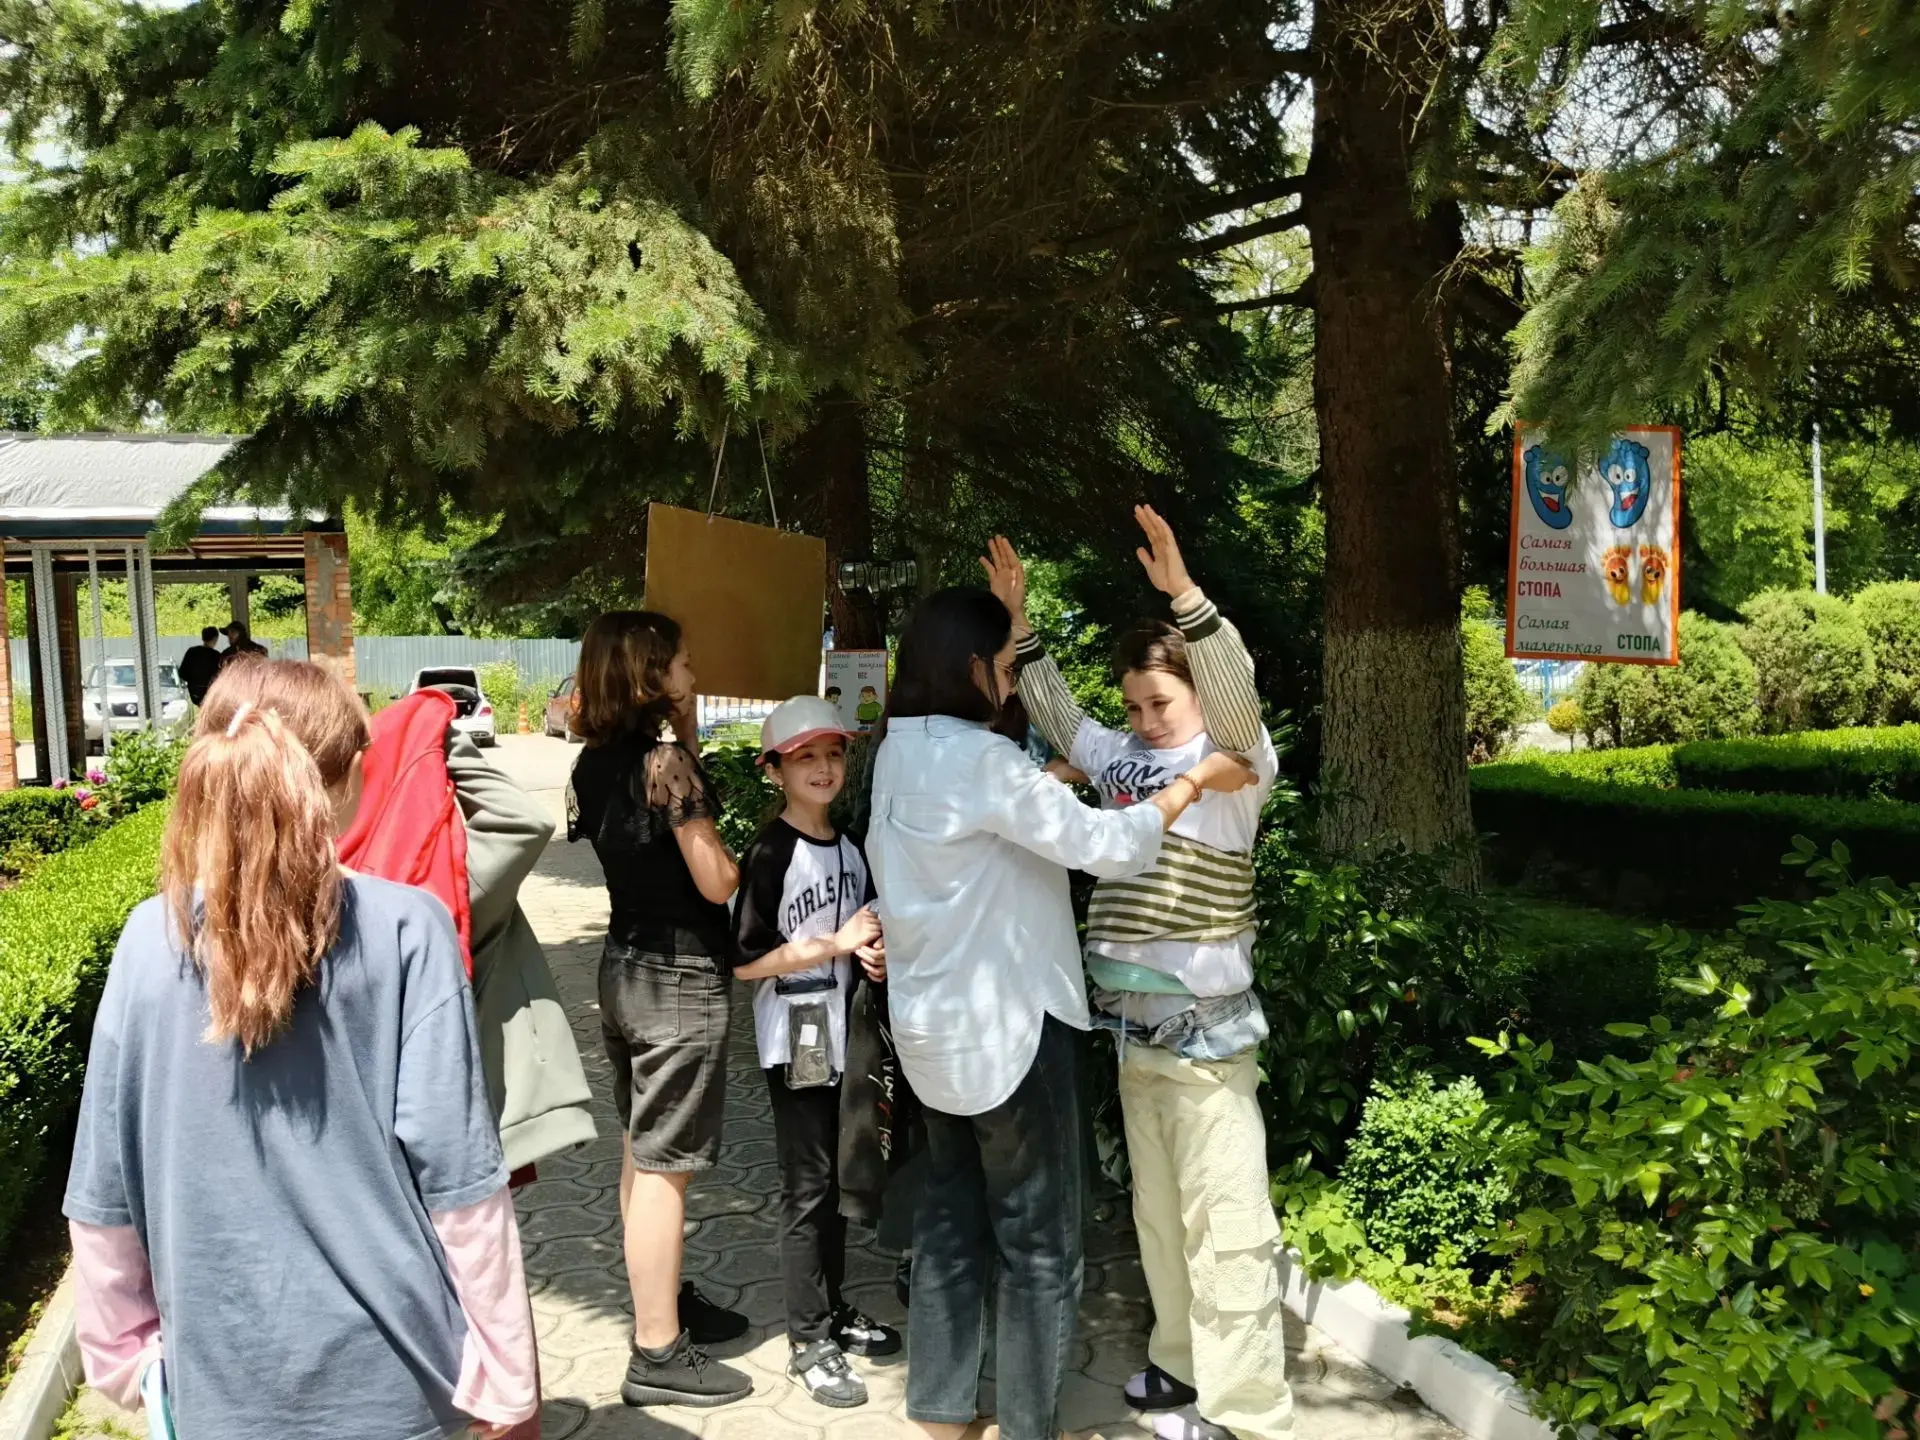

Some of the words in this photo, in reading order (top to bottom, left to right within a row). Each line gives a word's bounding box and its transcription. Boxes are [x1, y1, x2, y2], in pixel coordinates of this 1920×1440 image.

[1520, 535, 1572, 549] Самая
[1519, 555, 1587, 573] большая
[1518, 581, 1561, 598] СТОПА
[1517, 615, 1570, 630] Самая
[1516, 640, 1603, 655] маленькая
[1617, 634, 1661, 652] СТОПА
[788, 876, 836, 934] GIRLS
